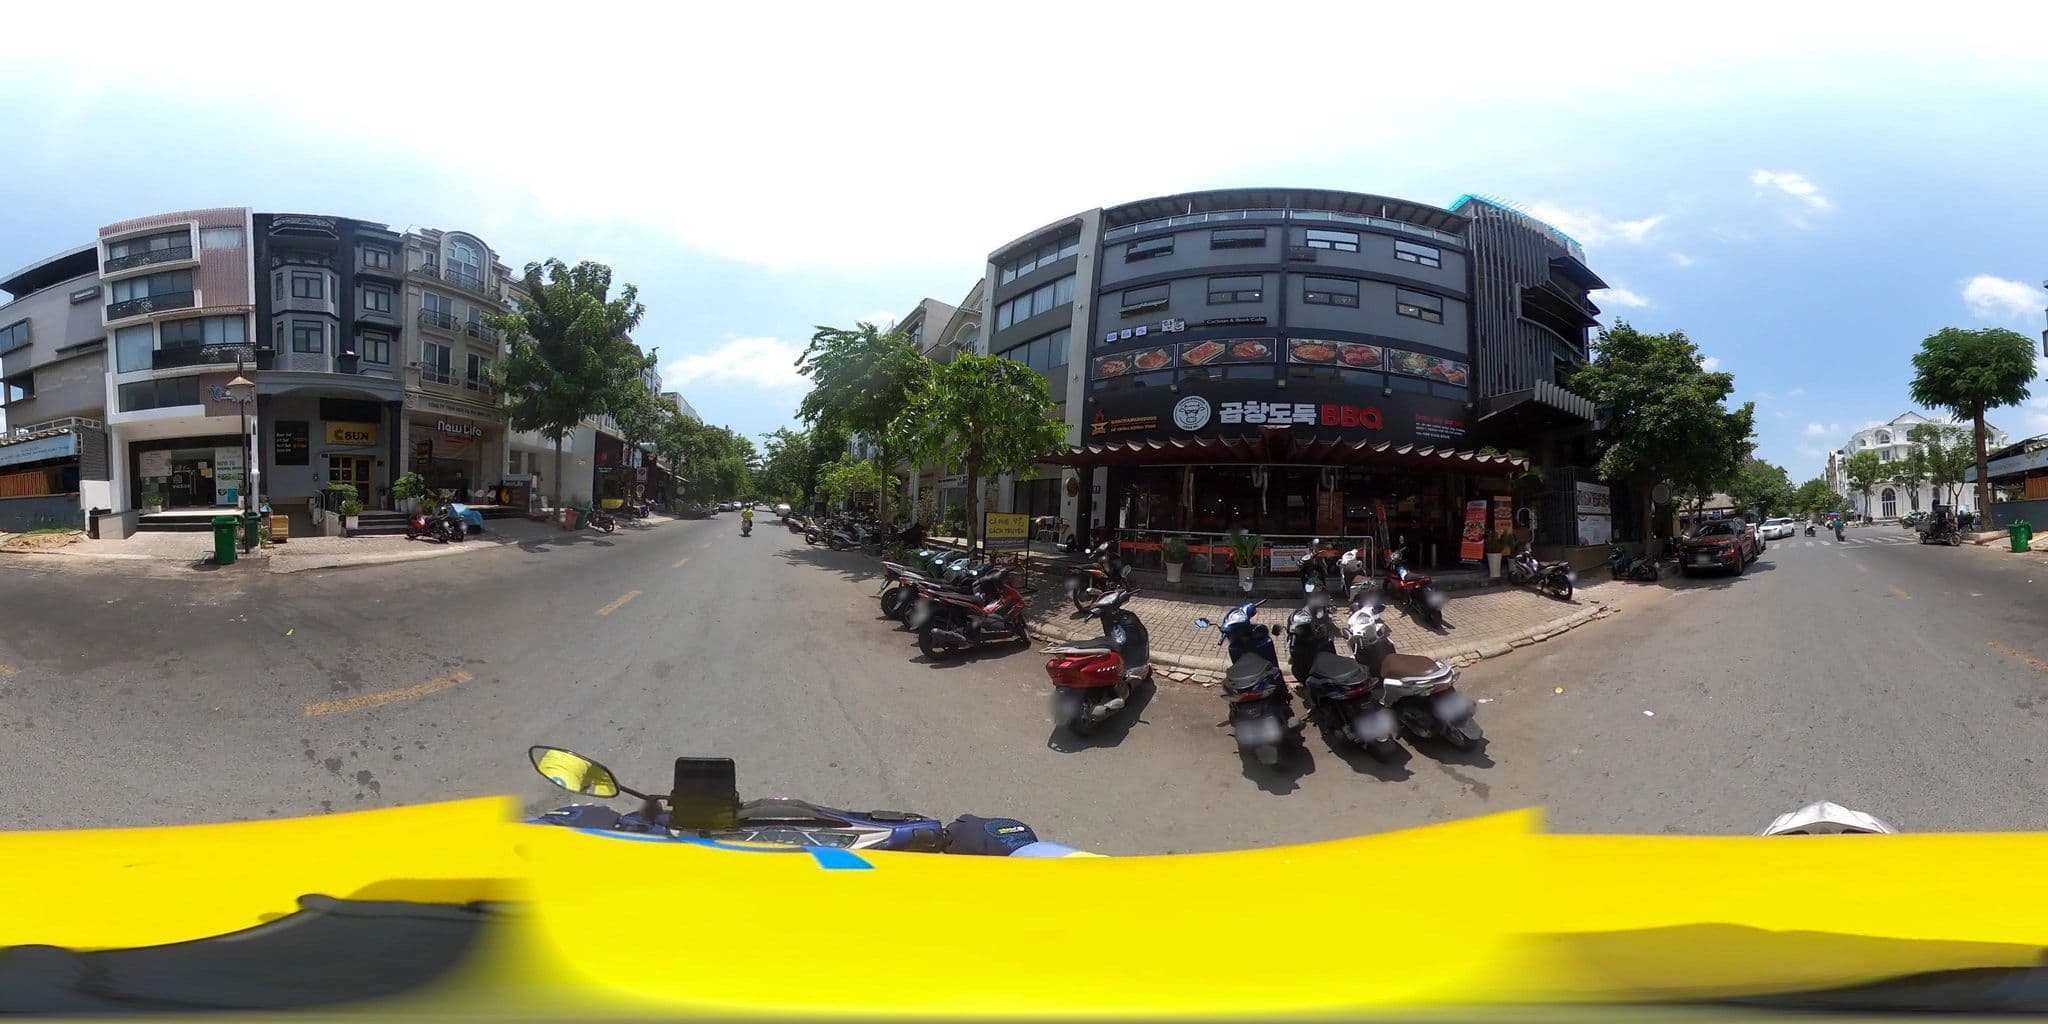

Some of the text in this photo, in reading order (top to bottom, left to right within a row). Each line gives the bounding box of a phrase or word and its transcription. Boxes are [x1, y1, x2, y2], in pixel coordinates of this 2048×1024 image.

[1220, 400, 1317, 426] 곱창도둑
[1321, 403, 1383, 431] BBQ
[344, 431, 369, 440] SUN
